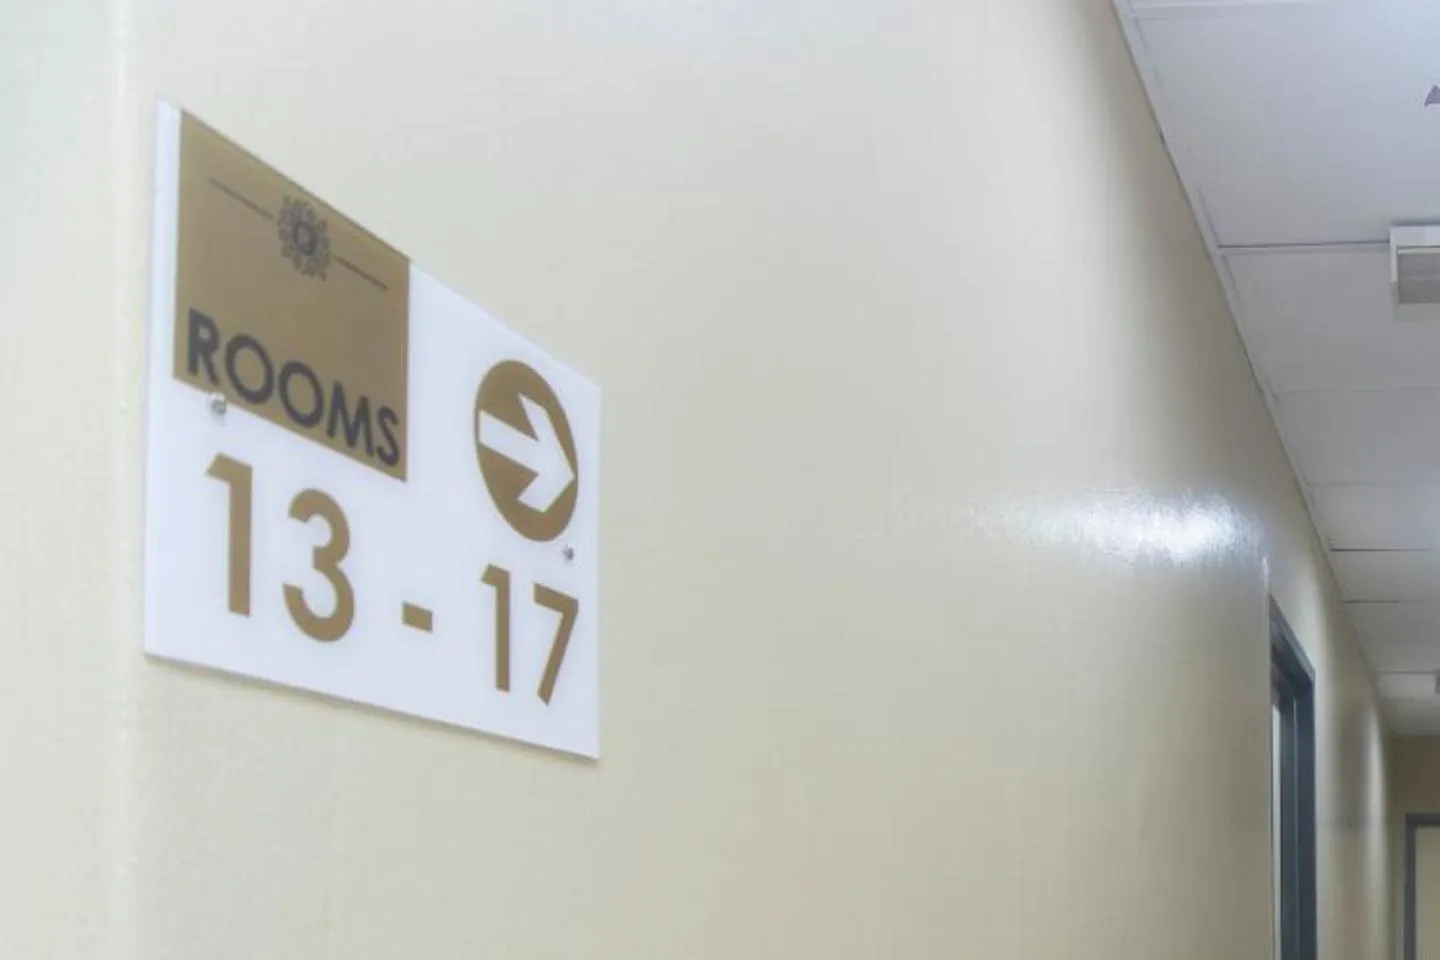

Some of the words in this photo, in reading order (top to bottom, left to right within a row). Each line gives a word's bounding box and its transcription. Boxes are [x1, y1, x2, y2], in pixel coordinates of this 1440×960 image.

[186, 308, 400, 467] ROOMS
[205, 452, 355, 643] 13
[480, 562, 579, 707] 17
